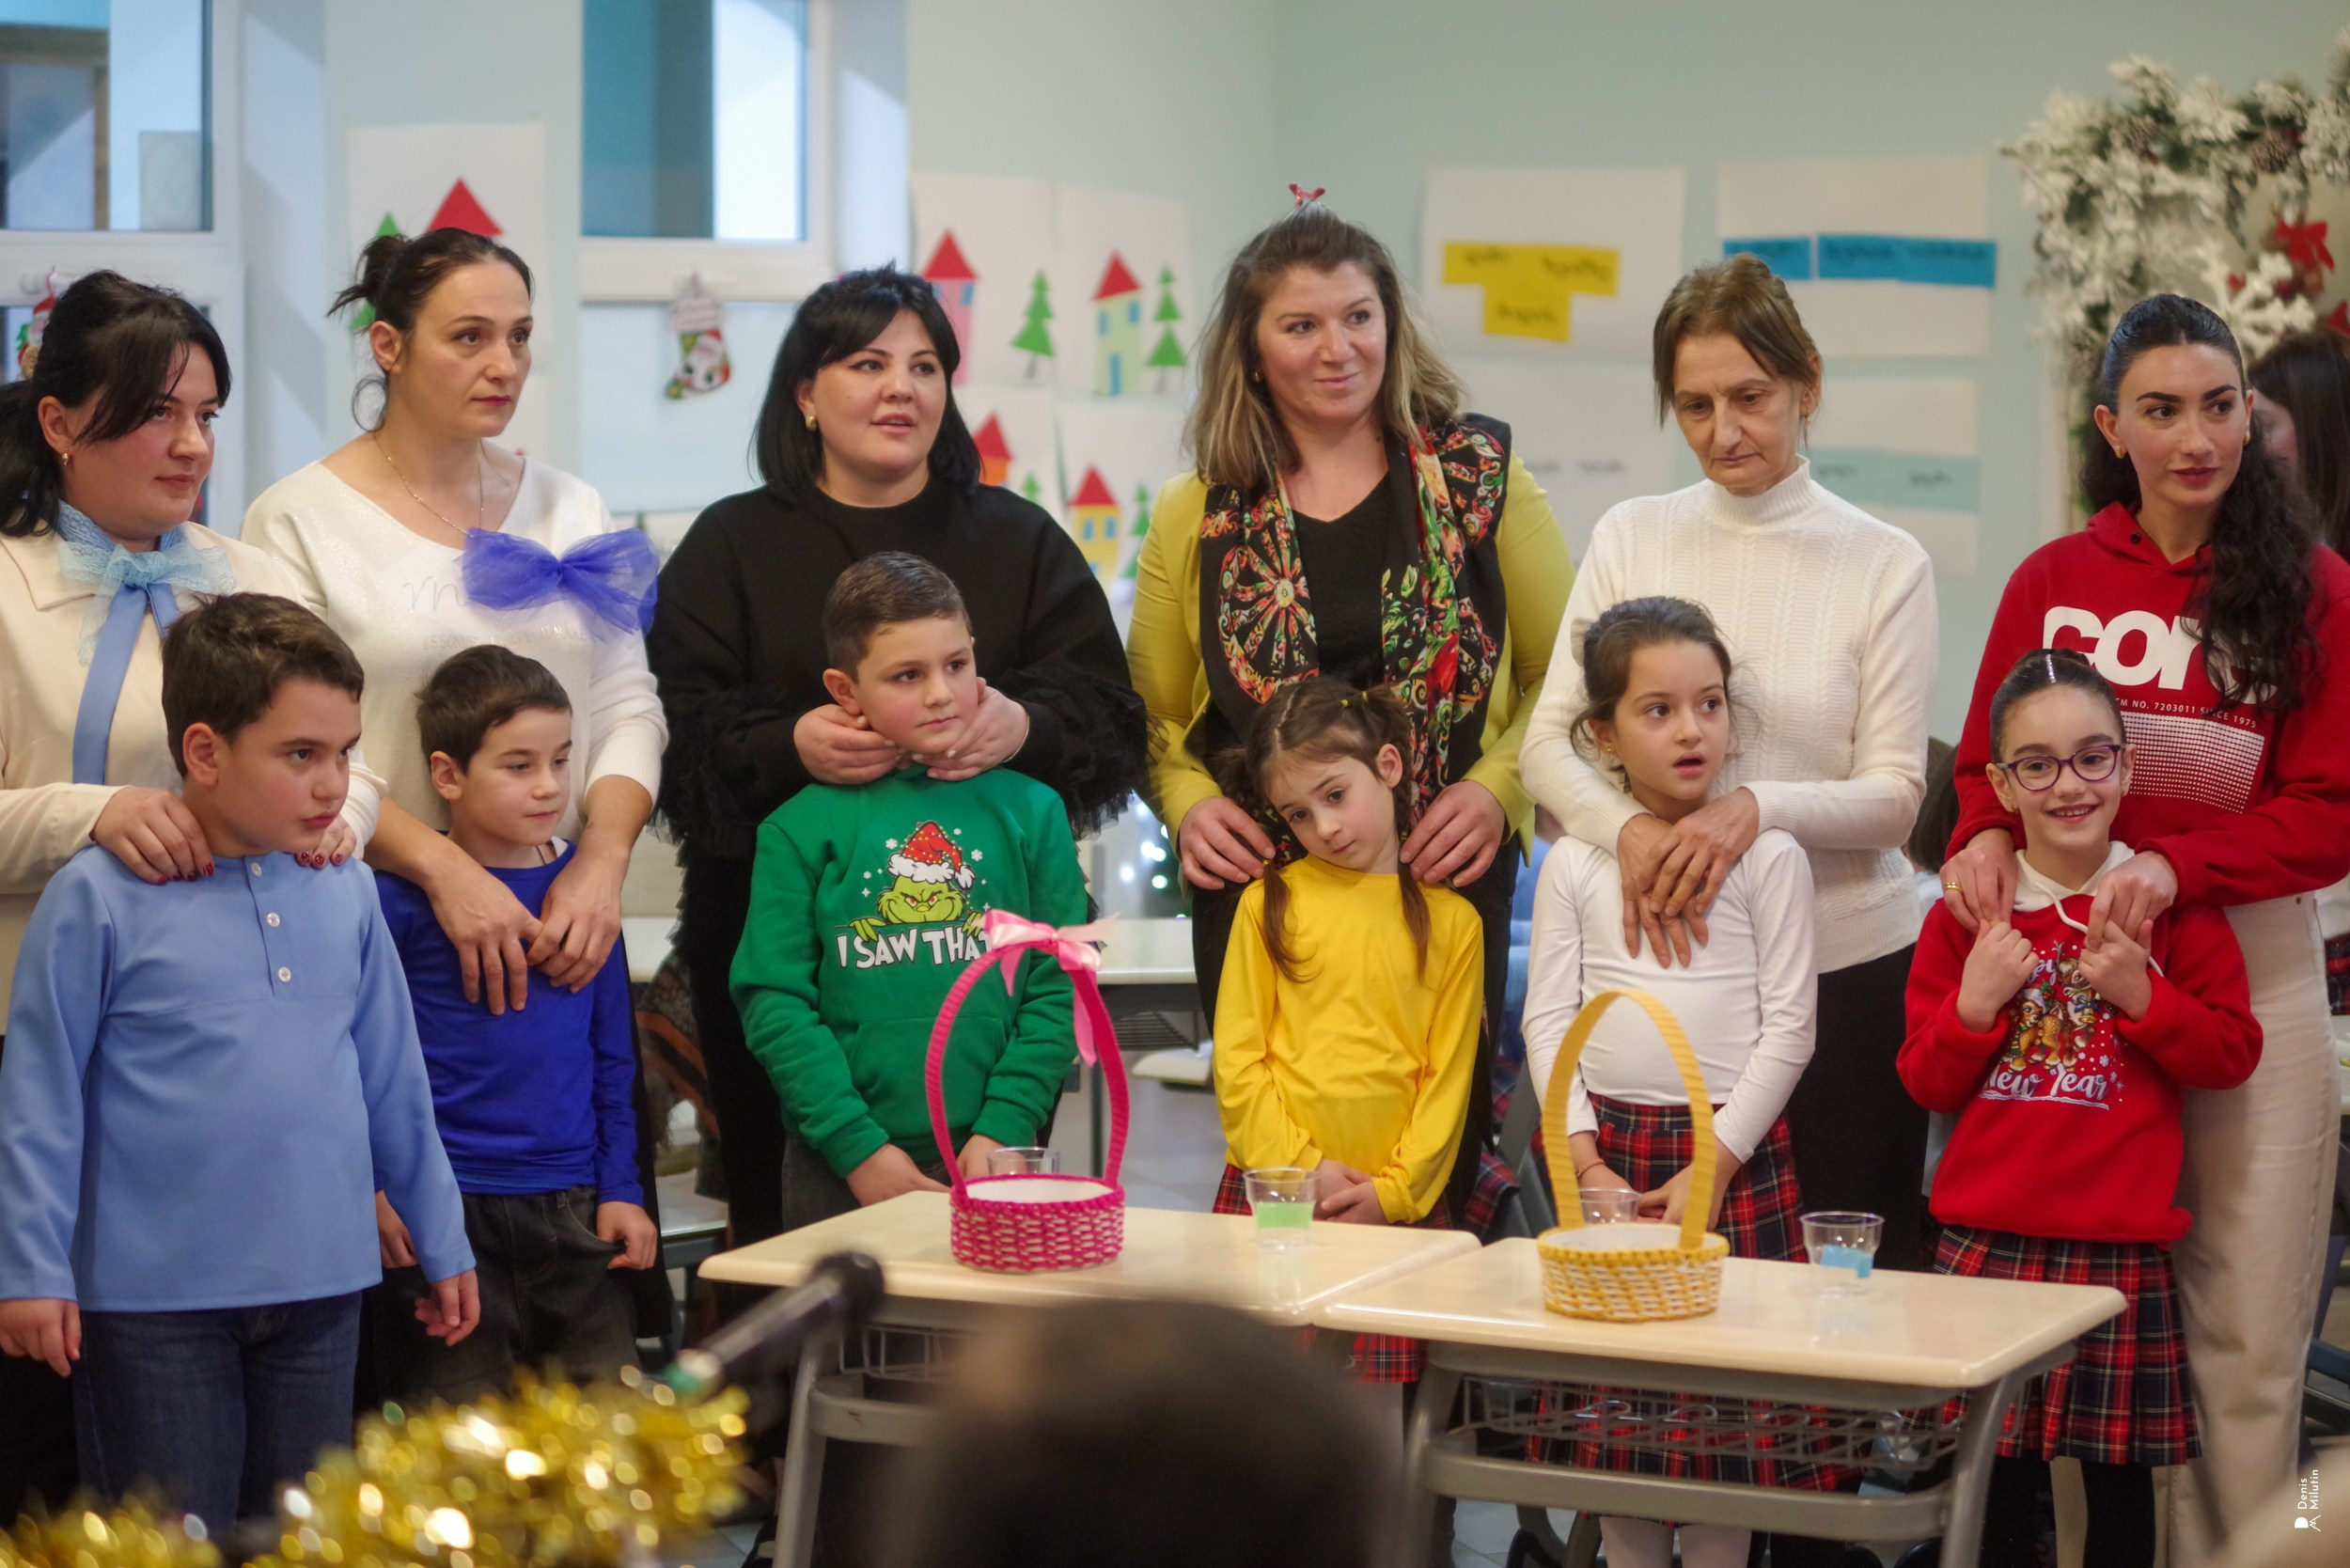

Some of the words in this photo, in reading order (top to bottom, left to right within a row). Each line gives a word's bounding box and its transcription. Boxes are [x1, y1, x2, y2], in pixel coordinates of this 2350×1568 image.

[2132, 699, 2150, 710] NO.
[2154, 701, 2196, 714] 7203011
[2233, 714, 2257, 729] 1975
[837, 934, 848, 968] I
[853, 927, 918, 969] SAW
[2049, 1062, 2107, 1101] Year
